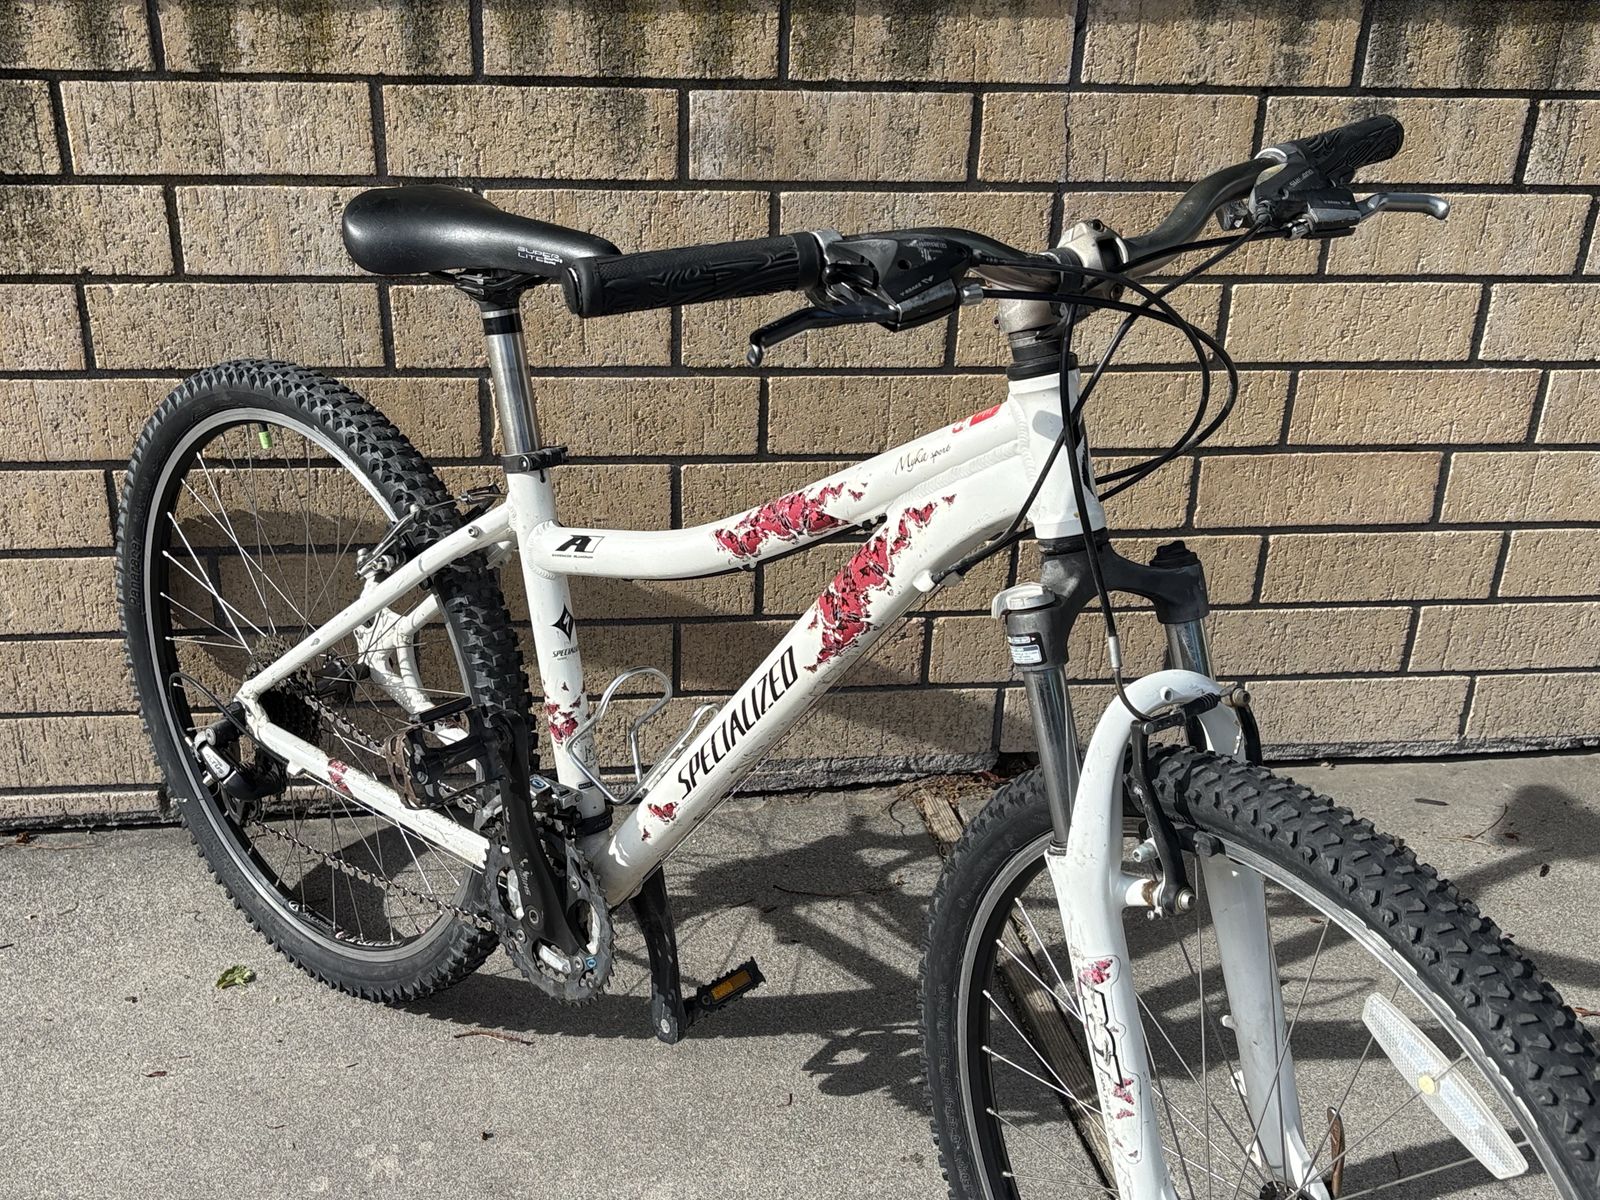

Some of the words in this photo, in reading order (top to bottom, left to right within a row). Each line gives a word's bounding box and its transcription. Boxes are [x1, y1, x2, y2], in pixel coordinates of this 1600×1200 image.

[517, 246, 560, 259] SUPER
[517, 252, 545, 263] LITE
[678, 645, 798, 799] SPECIALIZED
